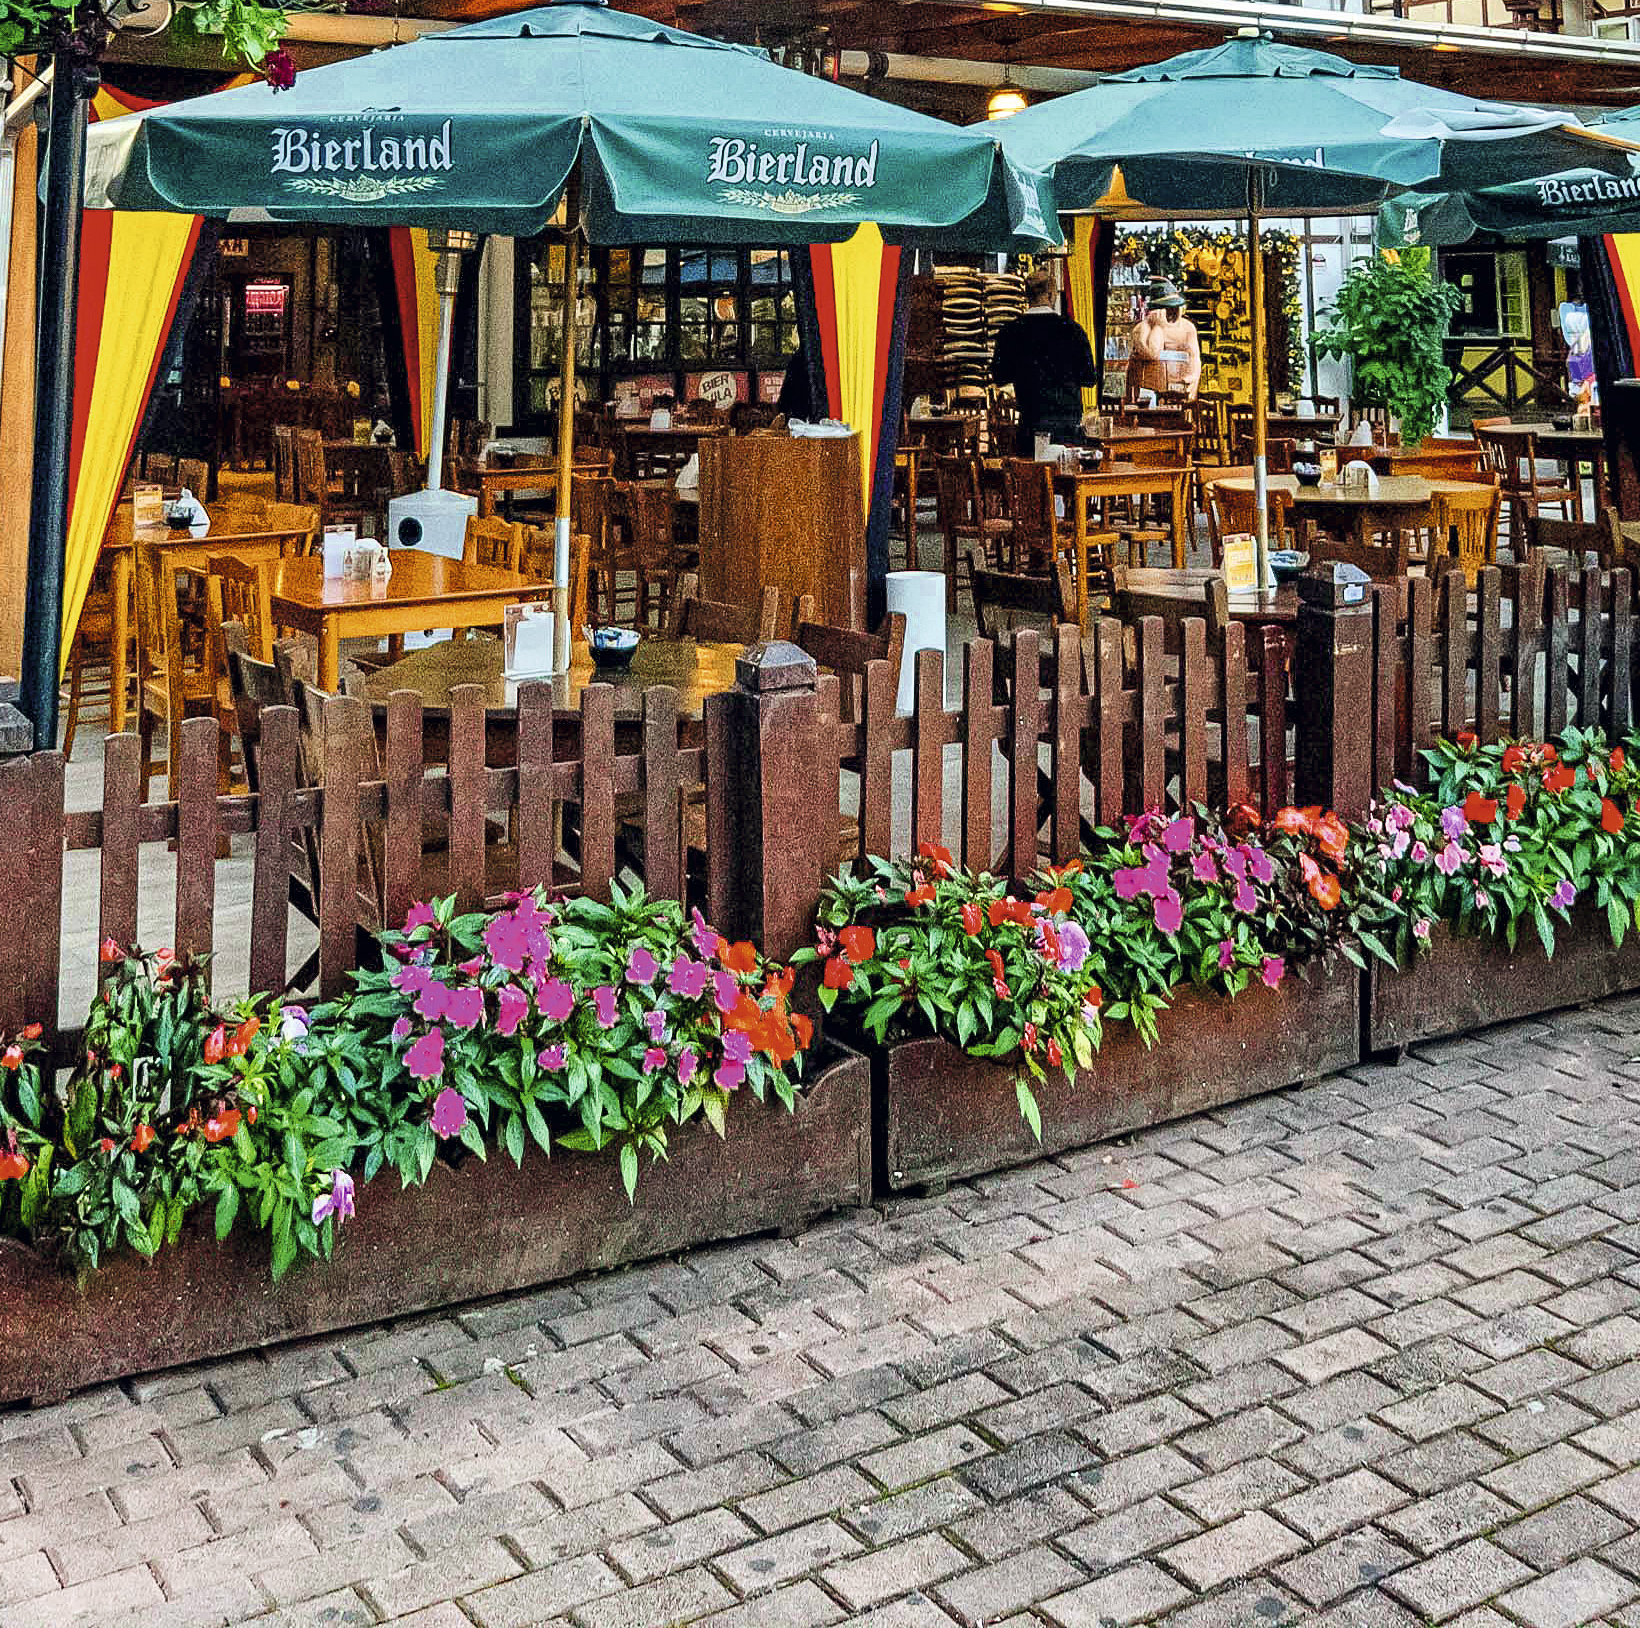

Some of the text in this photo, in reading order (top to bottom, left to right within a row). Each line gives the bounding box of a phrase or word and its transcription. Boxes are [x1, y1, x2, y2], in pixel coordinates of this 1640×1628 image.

[271, 116, 455, 173] Bierland
[706, 136, 879, 188] Bierland
[701, 372, 729, 394] BIER
